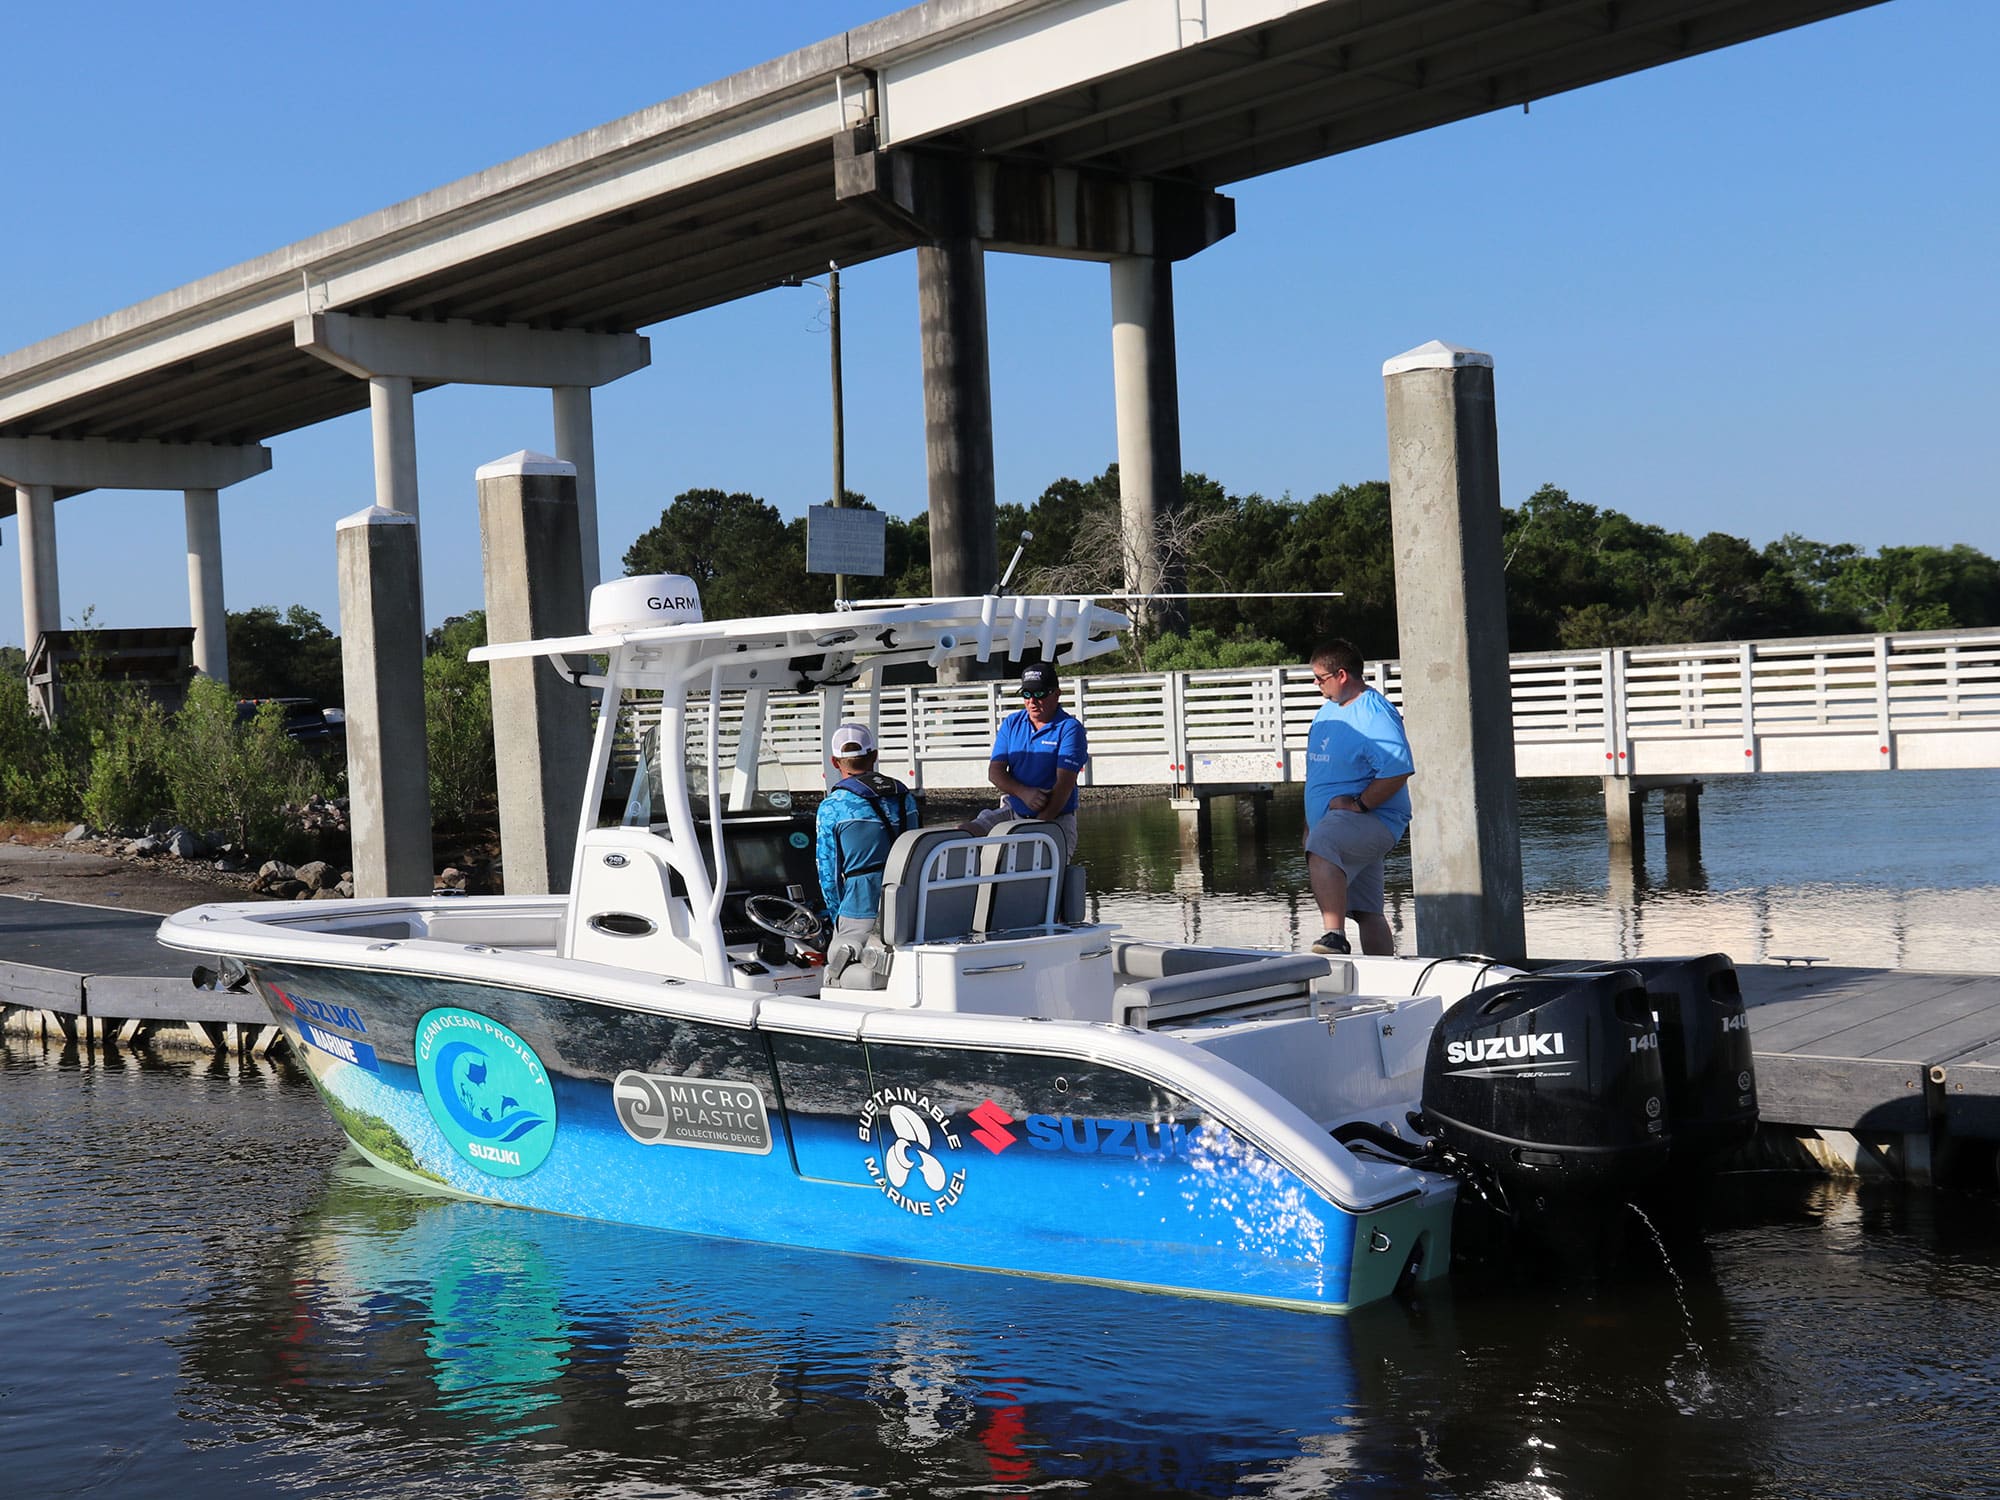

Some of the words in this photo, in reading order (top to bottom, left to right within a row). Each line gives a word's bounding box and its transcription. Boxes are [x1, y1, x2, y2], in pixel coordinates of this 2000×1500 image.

[647, 597, 699, 610] GARMI
[287, 992, 368, 1033] SUZUKI
[1721, 1013, 1748, 1033] 140
[308, 1025, 359, 1064] MARINE
[420, 1020, 443, 1060] CLEAN
[439, 1015, 482, 1031] OCEAN
[484, 1023, 546, 1087] PROJECT
[1447, 1032, 1564, 1064] SUZUKI
[1628, 1032, 1658, 1053] 140
[669, 1086, 753, 1109] MICRO
[672, 1106, 759, 1130] PLASTIC
[858, 1087, 962, 1150] SUSTAINABLE
[675, 1127, 729, 1140] COLLECTING
[730, 1133, 761, 1144] DEVICE
[1025, 1113, 1226, 1158] SUZUK
[468, 1142, 521, 1166] SUZUKI
[864, 1157, 933, 1216] MARINE
[934, 1168, 966, 1213] FUEL
